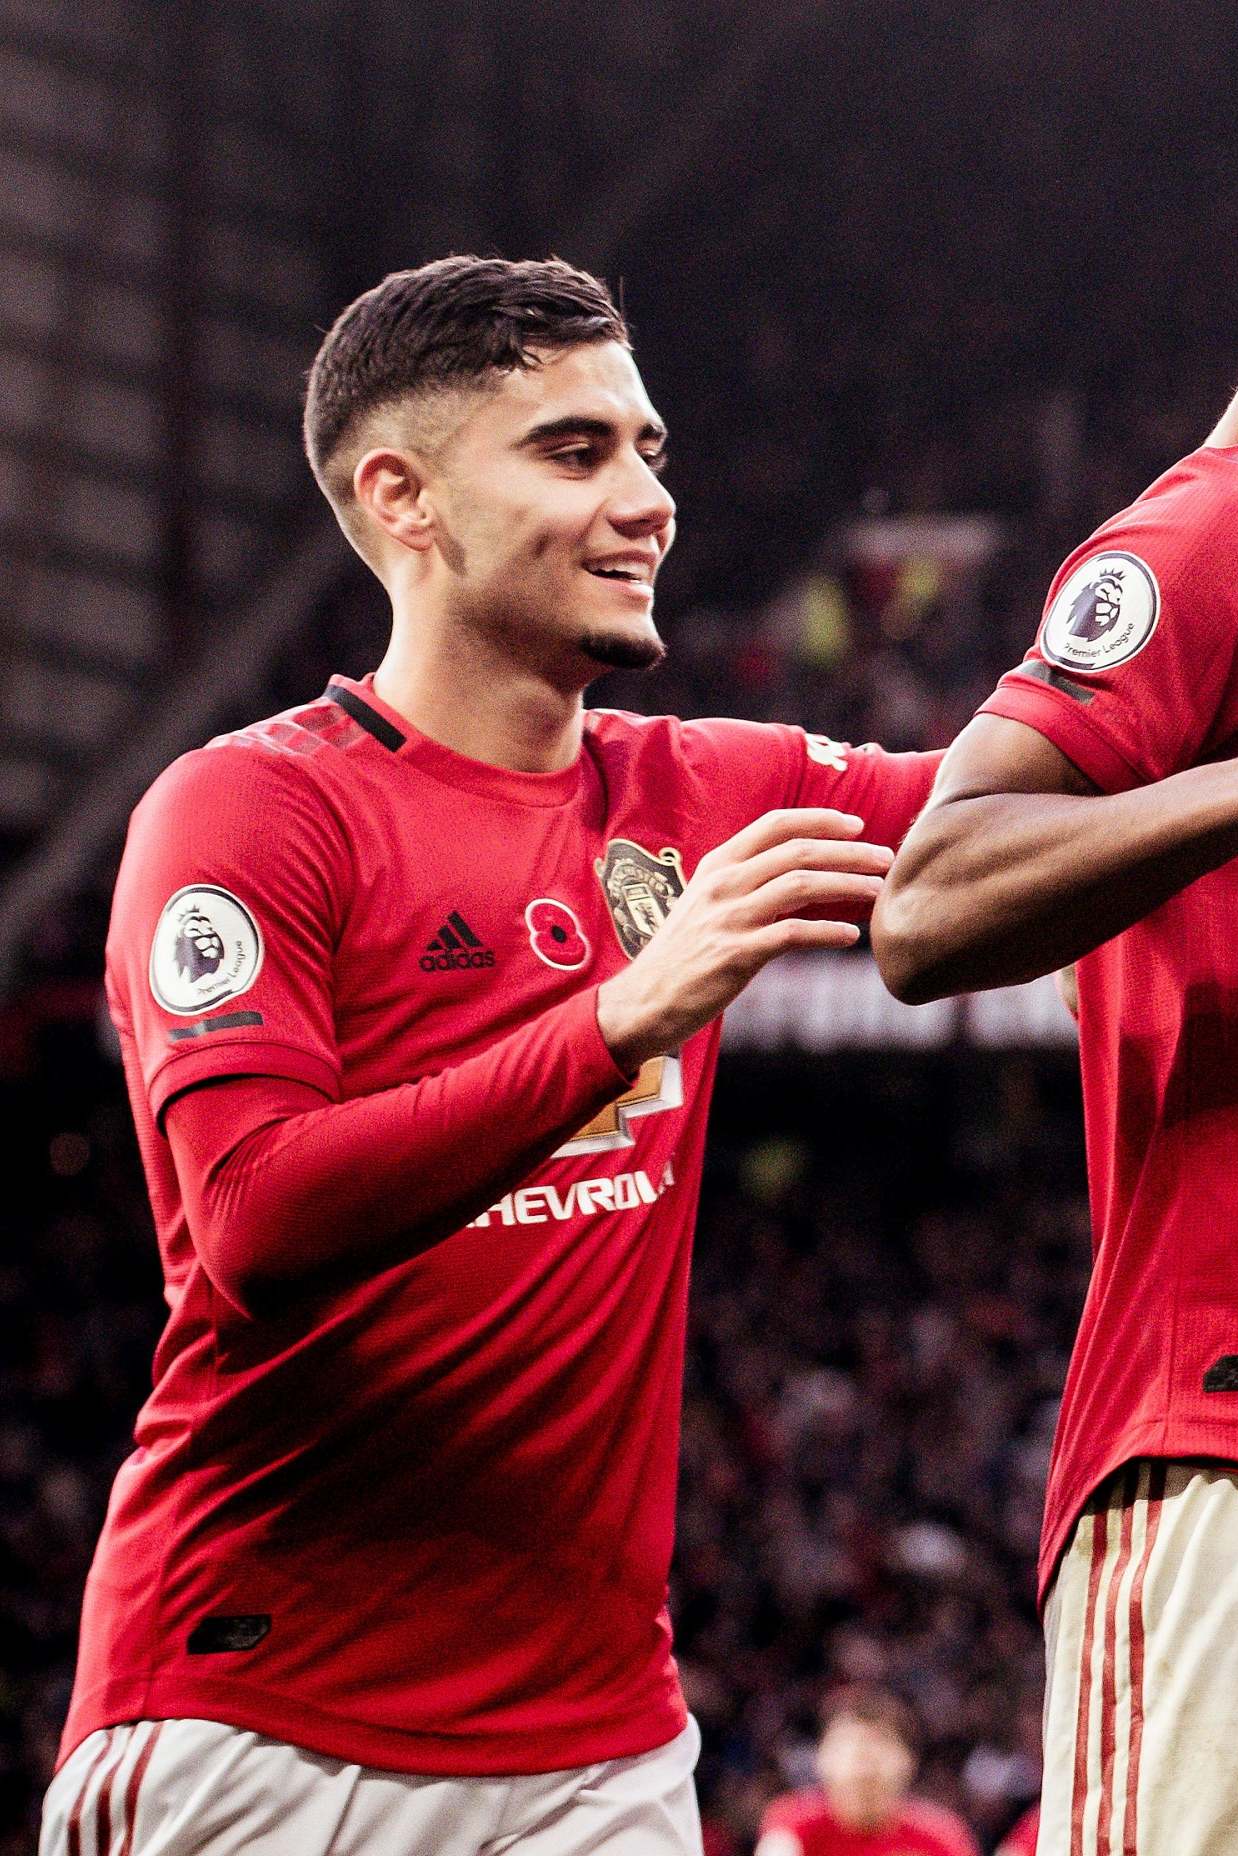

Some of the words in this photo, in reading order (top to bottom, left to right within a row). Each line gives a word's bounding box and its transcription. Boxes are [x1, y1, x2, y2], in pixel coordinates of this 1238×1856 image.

[1064, 642, 1101, 657] Premier
[1102, 622, 1135, 653] League
[418, 949, 497, 972] adidas
[465, 1160, 675, 1229] HEVROL
